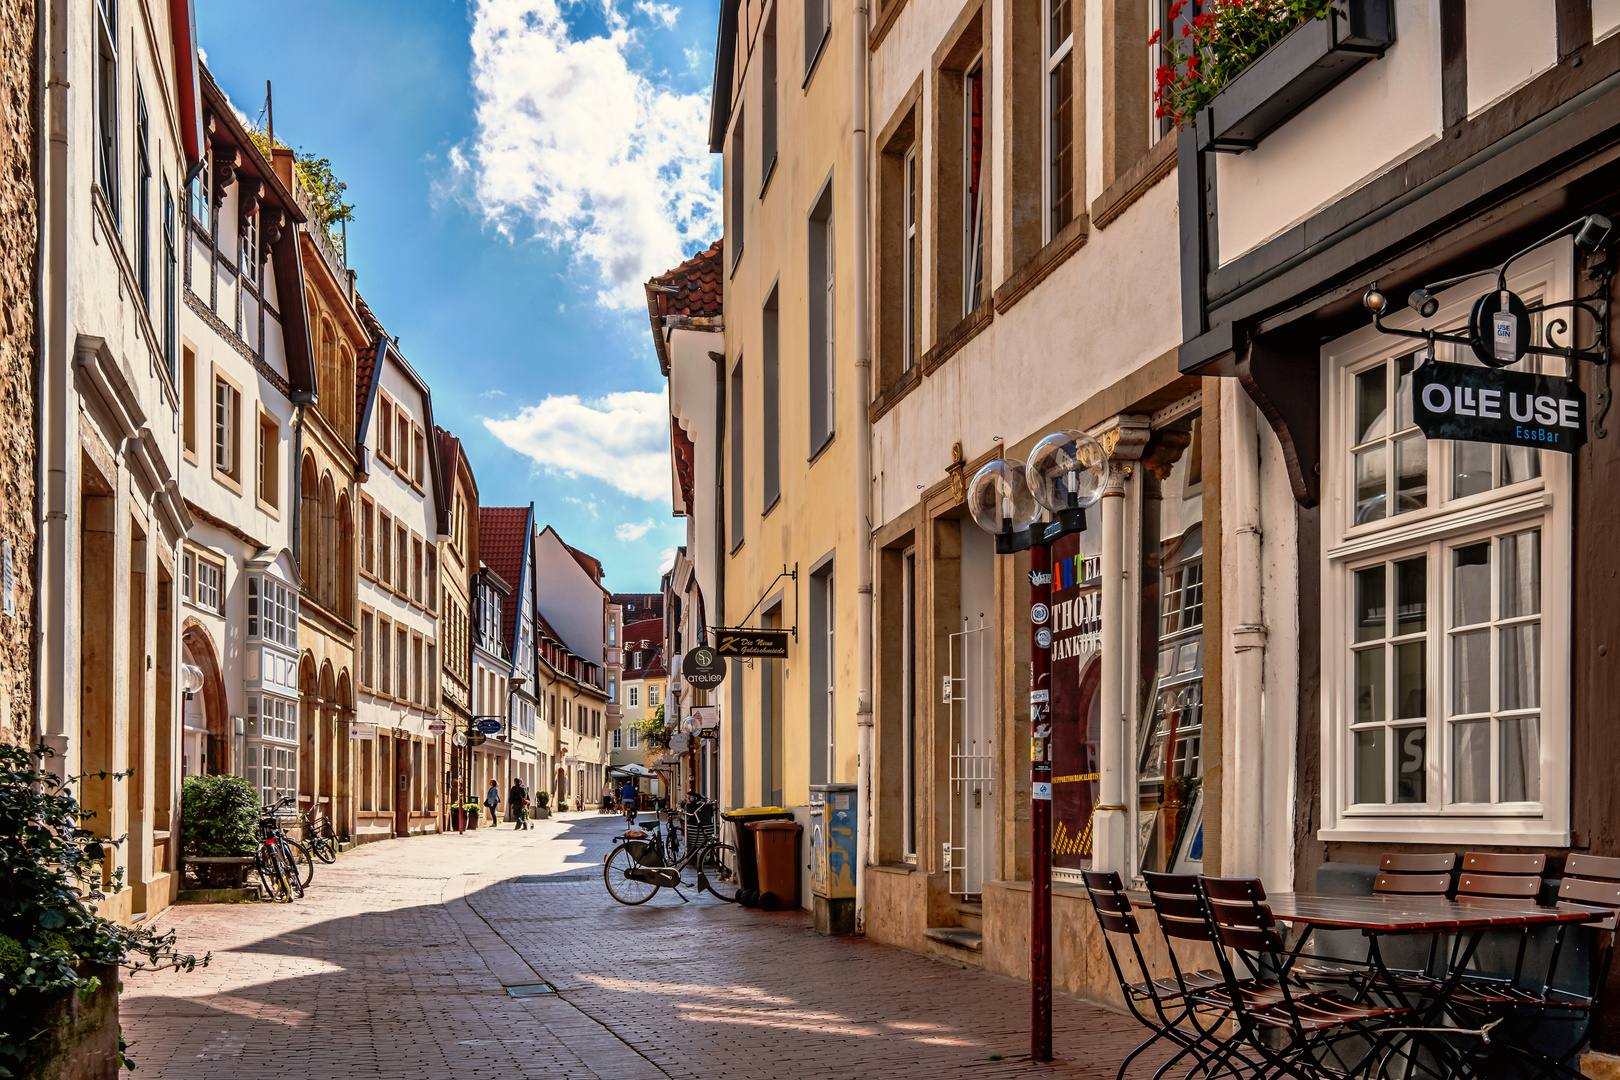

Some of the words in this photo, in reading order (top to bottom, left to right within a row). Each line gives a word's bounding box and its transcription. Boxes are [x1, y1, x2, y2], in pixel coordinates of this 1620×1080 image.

[1497, 323, 1511, 331] USE
[1497, 330, 1511, 338] GIN
[1421, 382, 1502, 420] OLLE
[1509, 391, 1580, 429] USE
[1516, 425, 1560, 443] EssBar
[1052, 592, 1102, 633] THOM
[740, 638, 754, 646] Die
[755, 638, 774, 647] Neue
[740, 646, 785, 655] Goldschmiede
